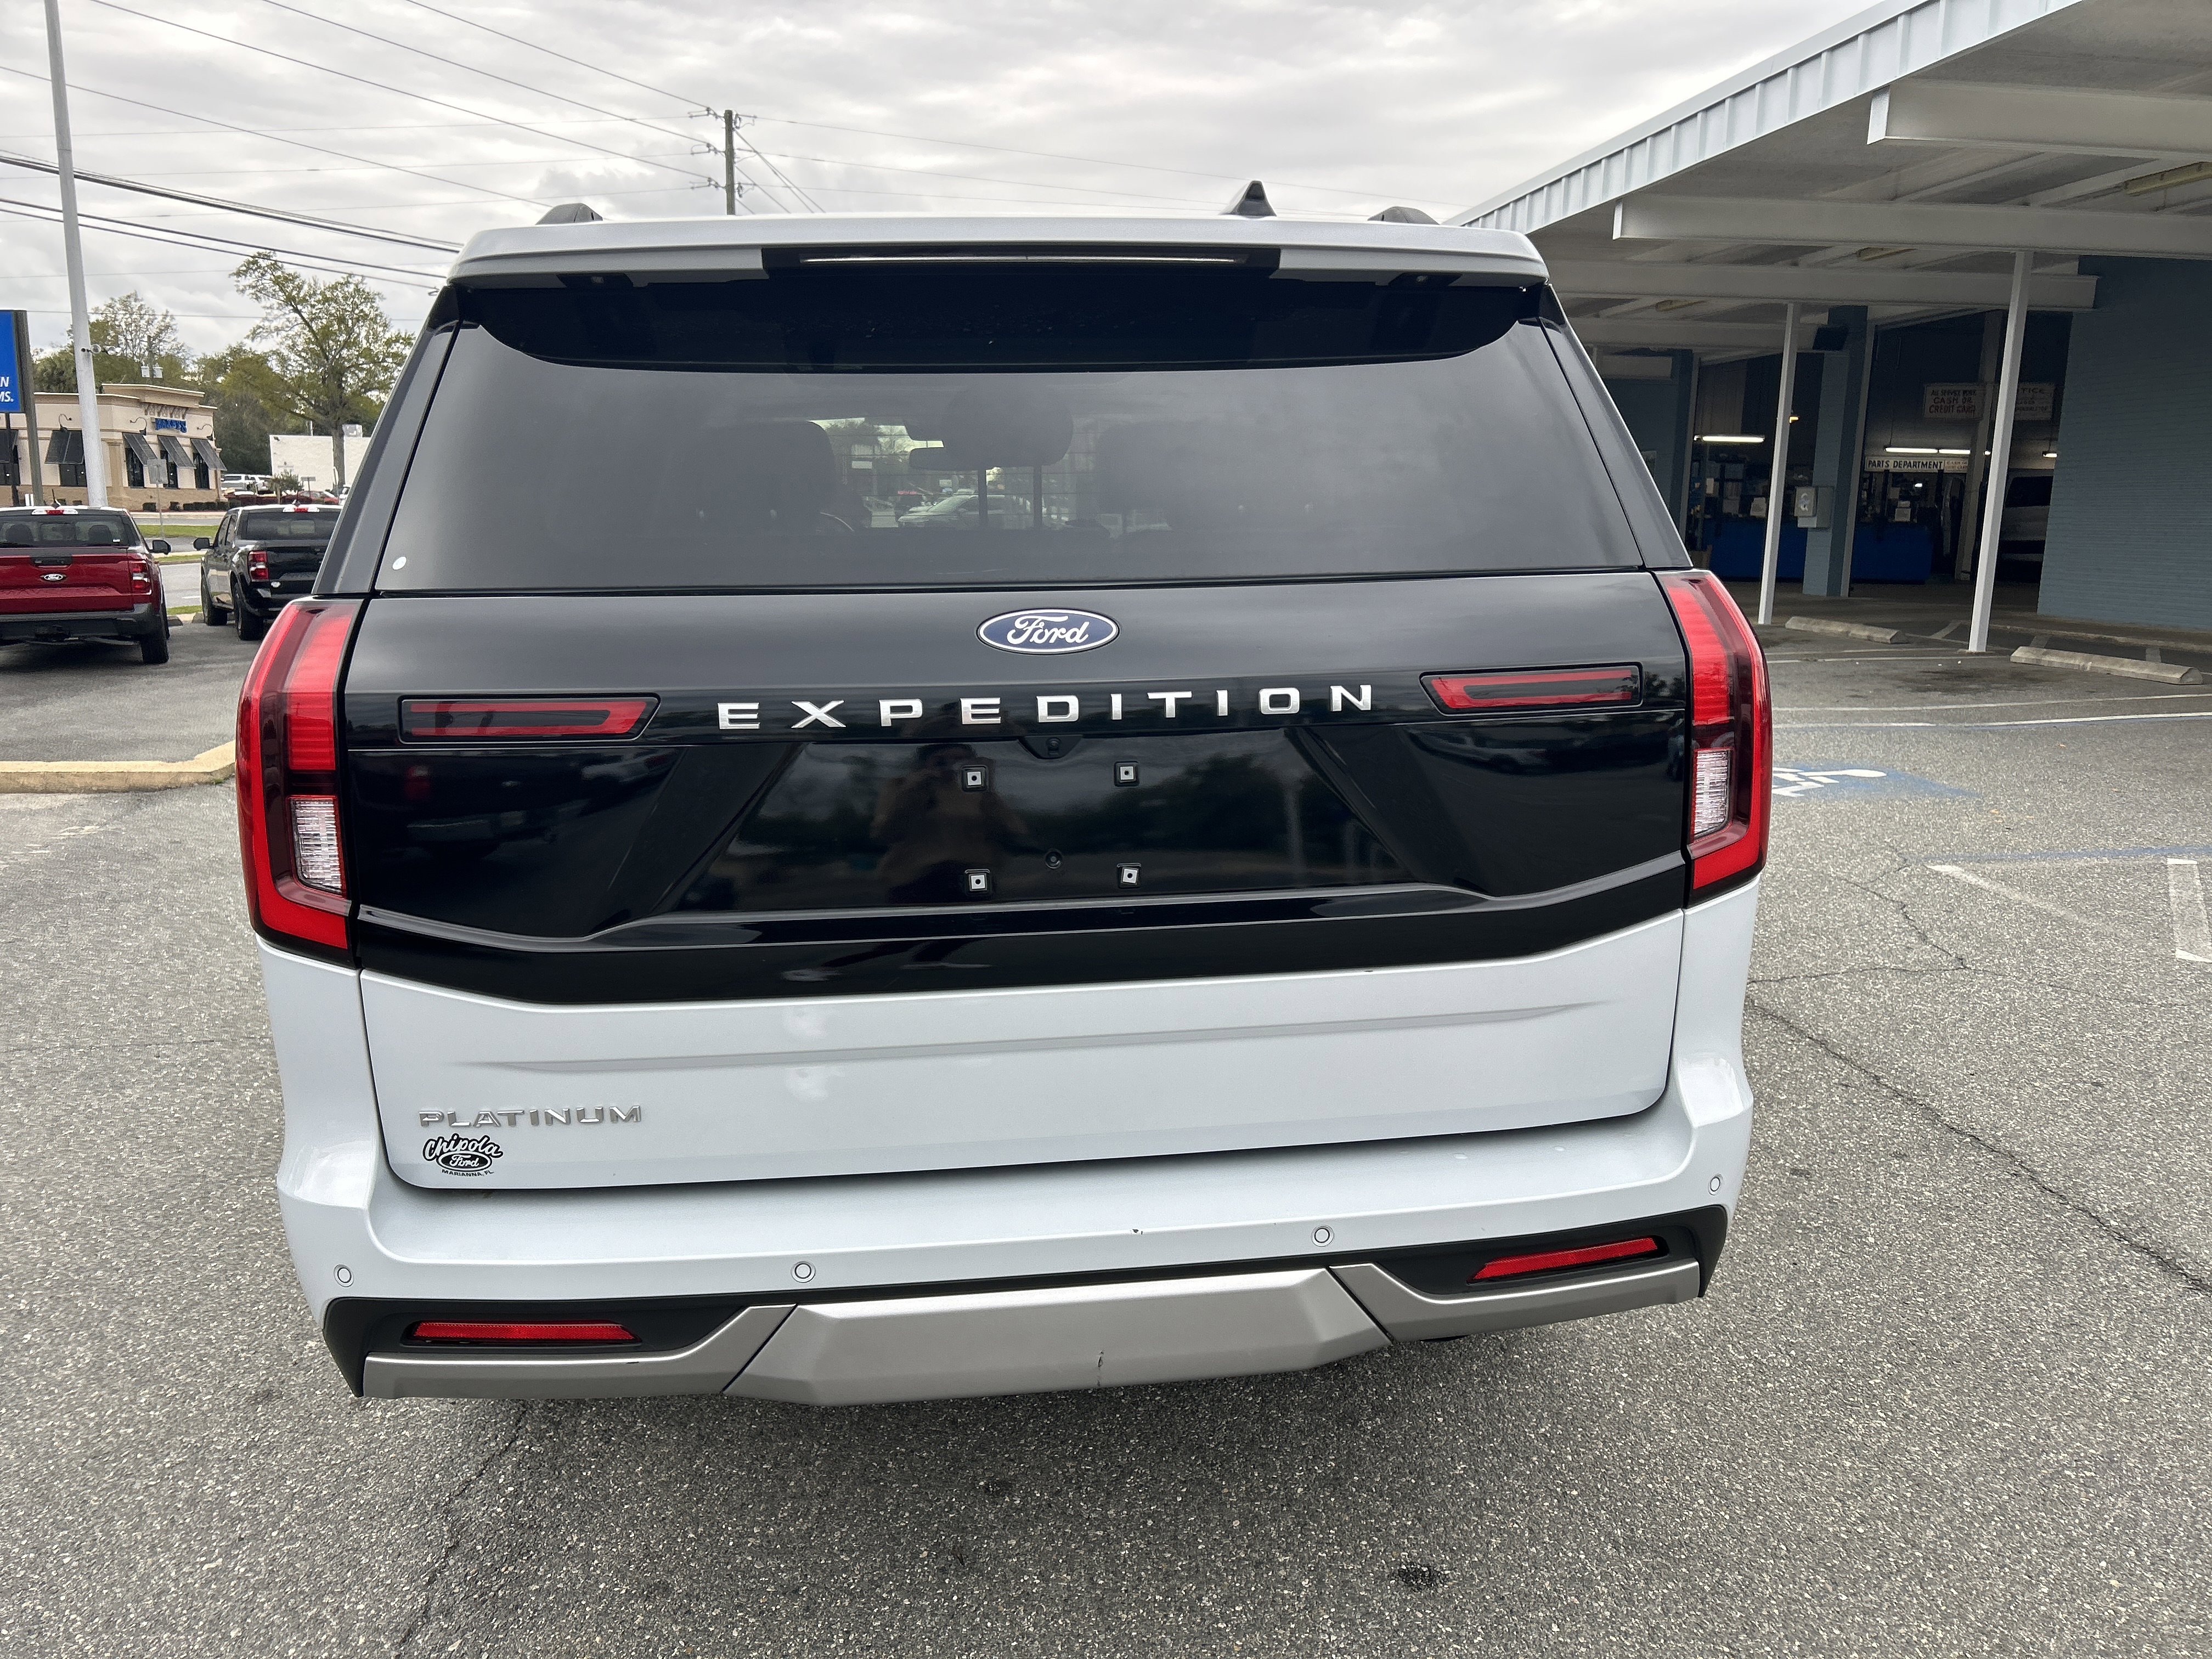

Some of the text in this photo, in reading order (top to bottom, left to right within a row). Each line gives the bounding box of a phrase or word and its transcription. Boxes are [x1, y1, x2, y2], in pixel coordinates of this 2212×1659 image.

[0, 376, 9, 387] N
[1929, 404, 1954, 413] CREDIT
[1868, 460, 1943, 469] PARTS DEPARTMENT
[1007, 615, 1090, 645] Ford
[717, 684, 1372, 730] EXPEDITION
[419, 1105, 641, 1127] PLATINUM
[424, 1134, 502, 1160] Chipola
[449, 1154, 479, 1167] Ford
